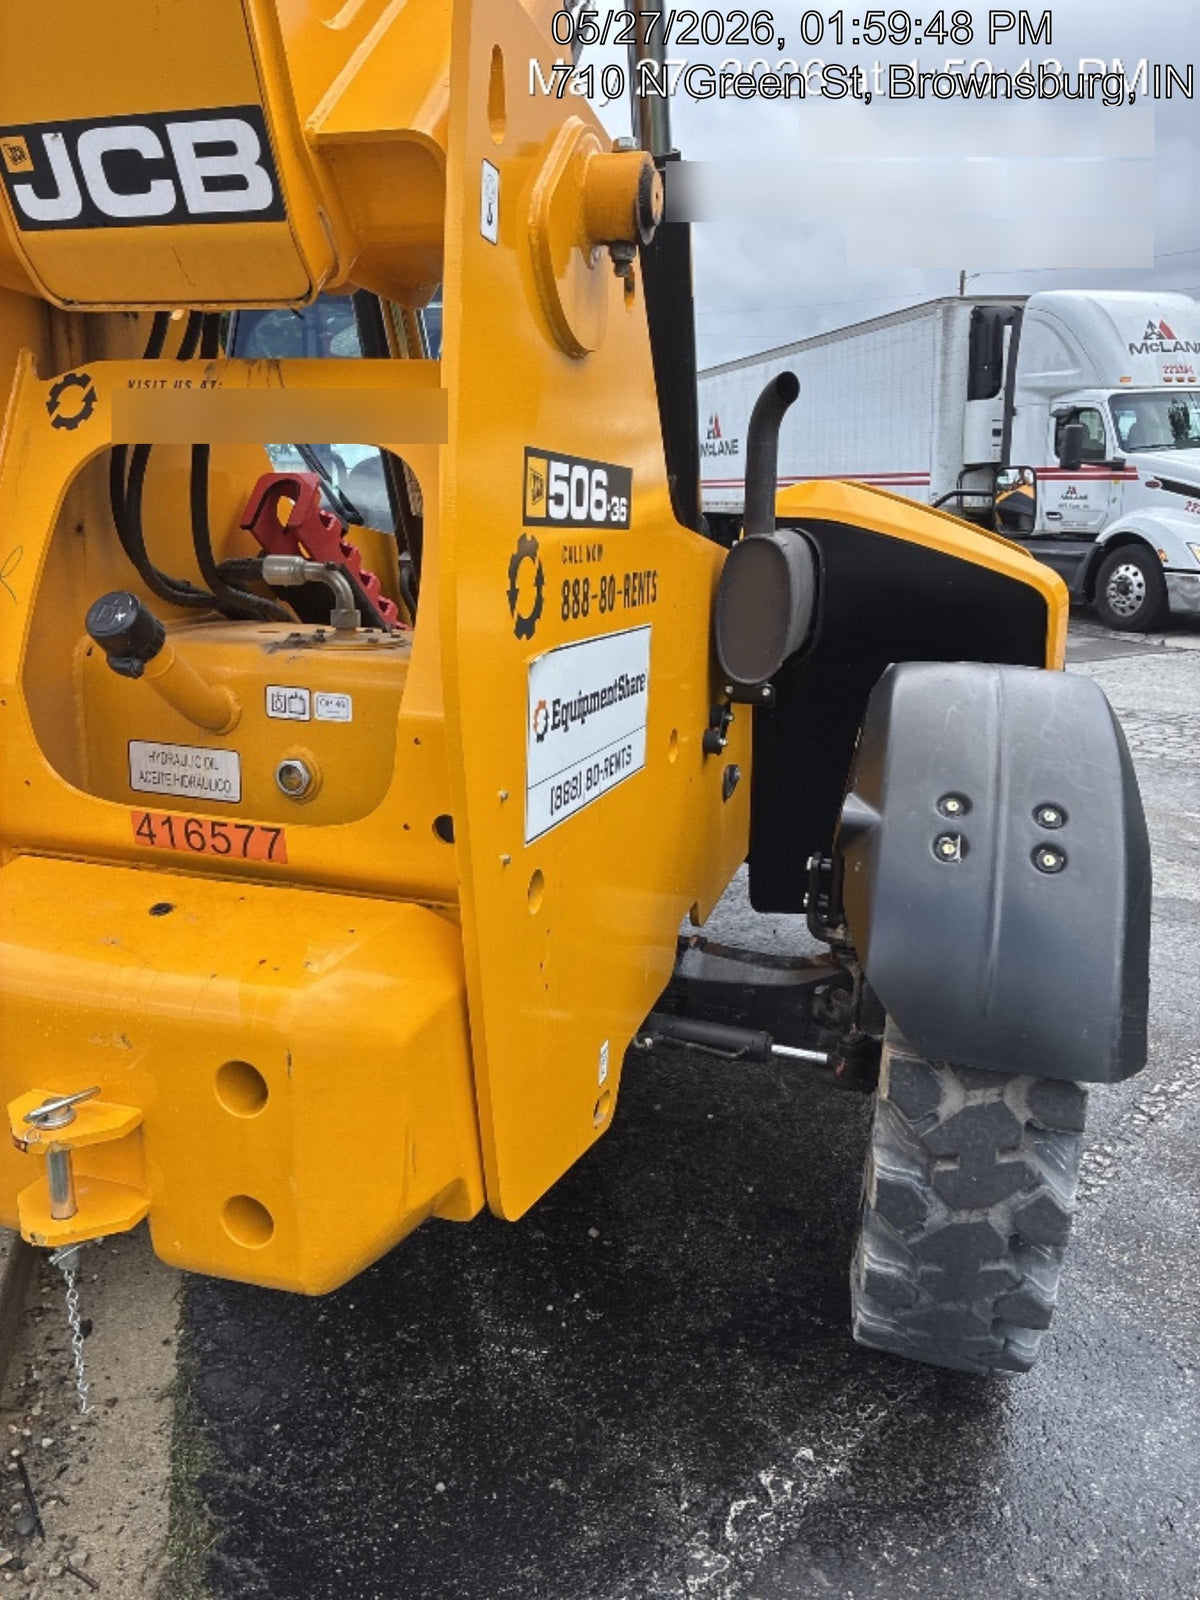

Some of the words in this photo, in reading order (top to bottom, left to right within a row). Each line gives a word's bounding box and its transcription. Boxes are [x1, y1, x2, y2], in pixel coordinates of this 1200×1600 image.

[13, 118, 275, 222] JCB
[561, 569, 658, 622] 888-80-RENTS
[551, 672, 646, 733] EquipmentShare
[148, 751, 202, 769] HYDRAULIC
[136, 812, 281, 860] 416577
